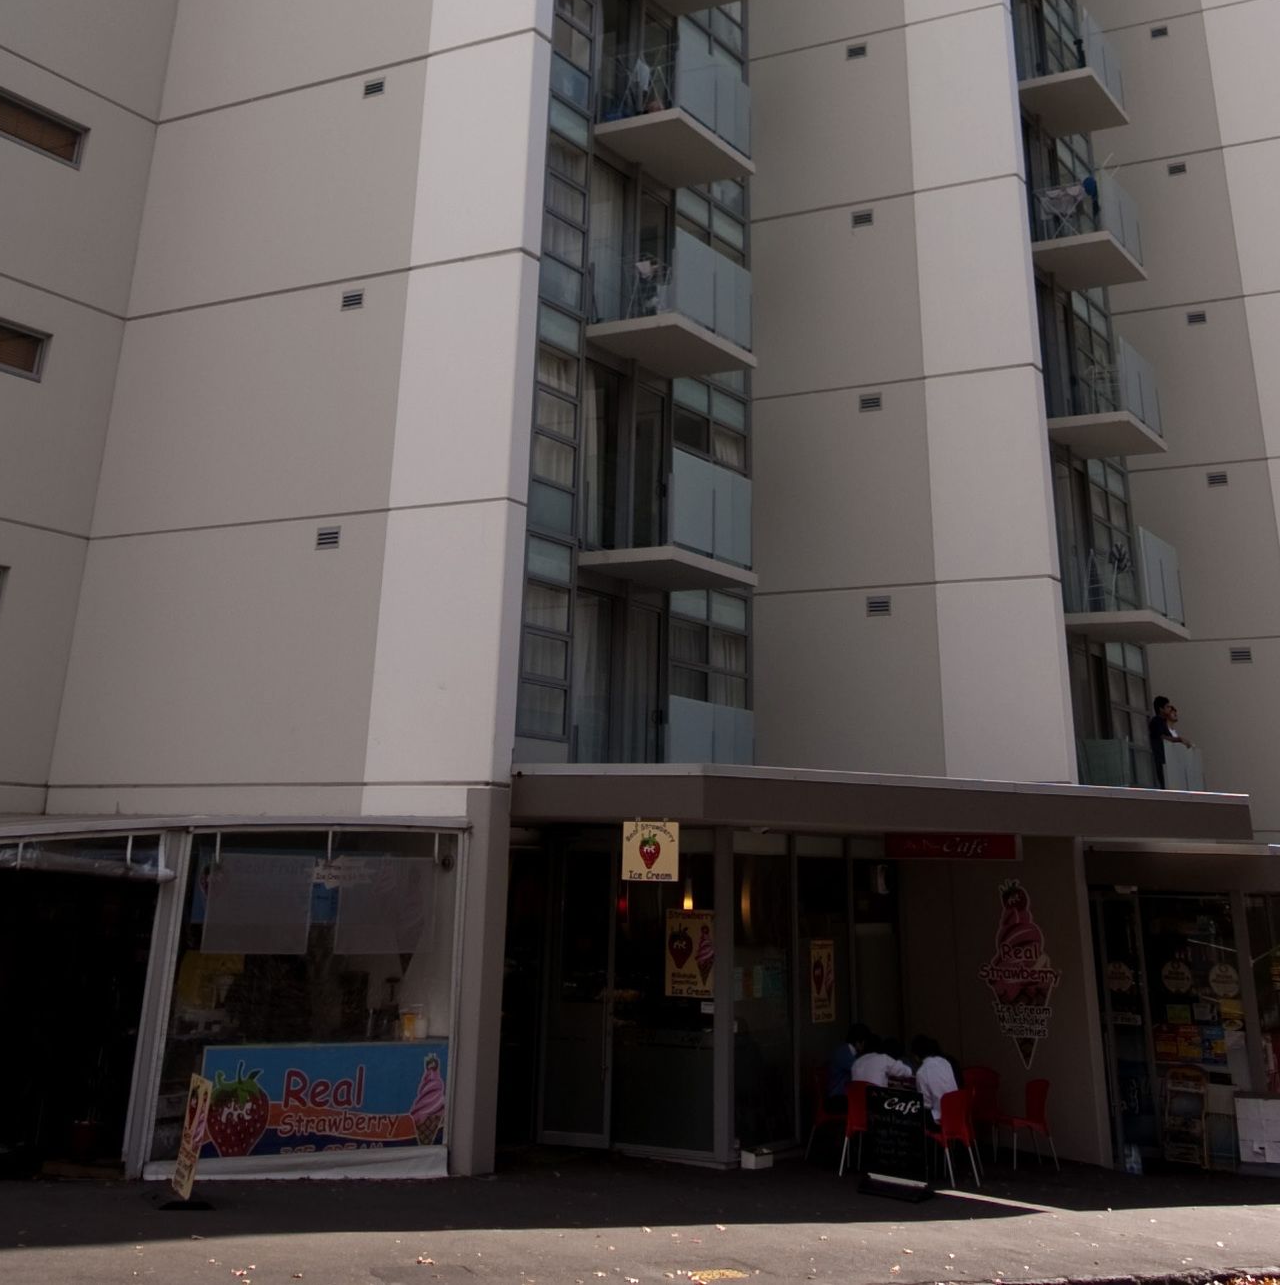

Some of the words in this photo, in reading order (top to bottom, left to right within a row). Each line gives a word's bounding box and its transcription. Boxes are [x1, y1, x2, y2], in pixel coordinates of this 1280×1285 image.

[629, 870, 642, 879] Ice
[646, 870, 673, 880] Cream
[1000, 942, 1039, 961] Real
[979, 963, 1058, 985] Strawberry
[1016, 1002, 1051, 1015] Cream
[282, 1065, 365, 1109] Real
[278, 1110, 400, 1138] Strawberry
